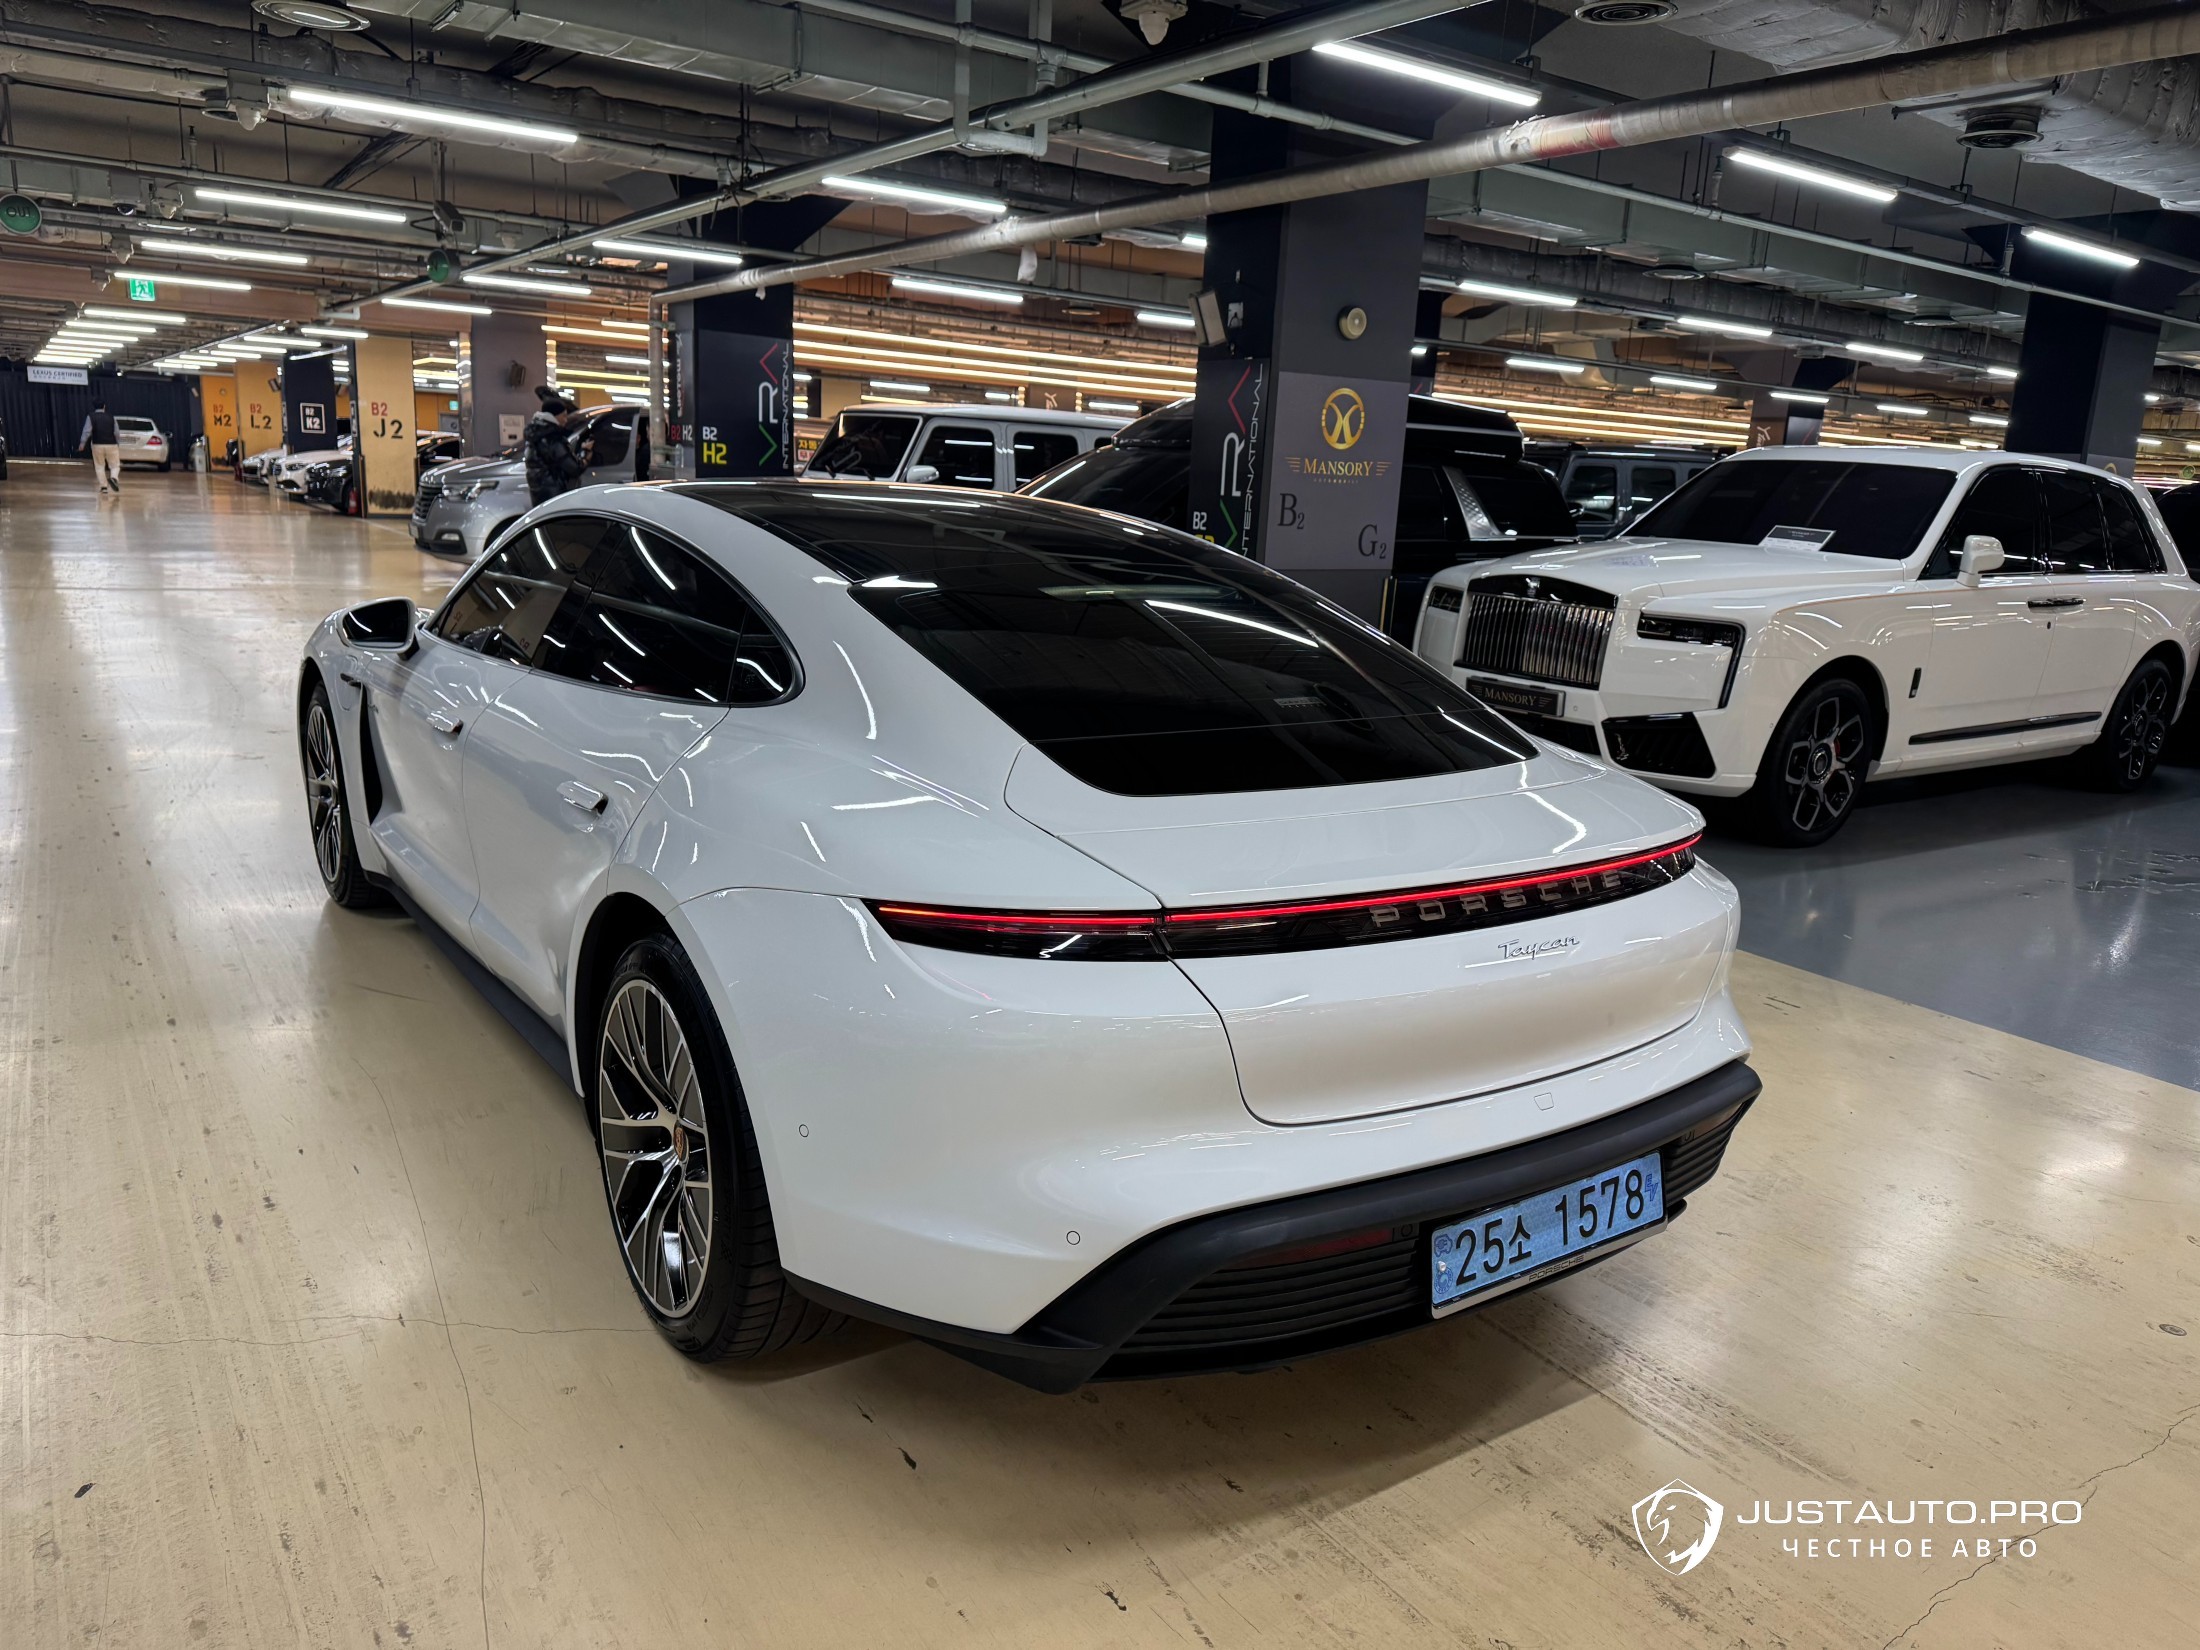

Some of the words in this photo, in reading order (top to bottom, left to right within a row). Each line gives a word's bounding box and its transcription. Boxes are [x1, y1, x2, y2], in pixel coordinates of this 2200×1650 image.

[213, 404, 224, 413] B2
[250, 403, 262, 414] B2
[371, 402, 388, 417] B2
[781, 342, 789, 469] INTERNATIONAL
[213, 414, 232, 427] M2
[250, 414, 272, 430] L2
[306, 417, 321, 430] K2
[373, 418, 403, 439] J2
[671, 425, 680, 440] B2
[682, 425, 693, 441] H2
[702, 426, 718, 441] B2
[703, 442, 727, 465] H2
[1241, 363, 1264, 556] NTERNATIONAL
[1303, 458, 1374, 477] MANSORY
[1192, 511, 1207, 531] B2
[1278, 493, 1305, 530] B2
[1358, 524, 1387, 560] G2
[1484, 688, 1537, 706] MANSORY
[1368, 869, 1622, 928] PORSCHE
[1498, 934, 1581, 961] Taycan
[1644, 1173, 1659, 1202] EV
[1455, 1214, 1532, 1287] 25소
[1554, 1168, 1645, 1246] 1578
[1528, 1254, 1585, 1282] PORSCHE
